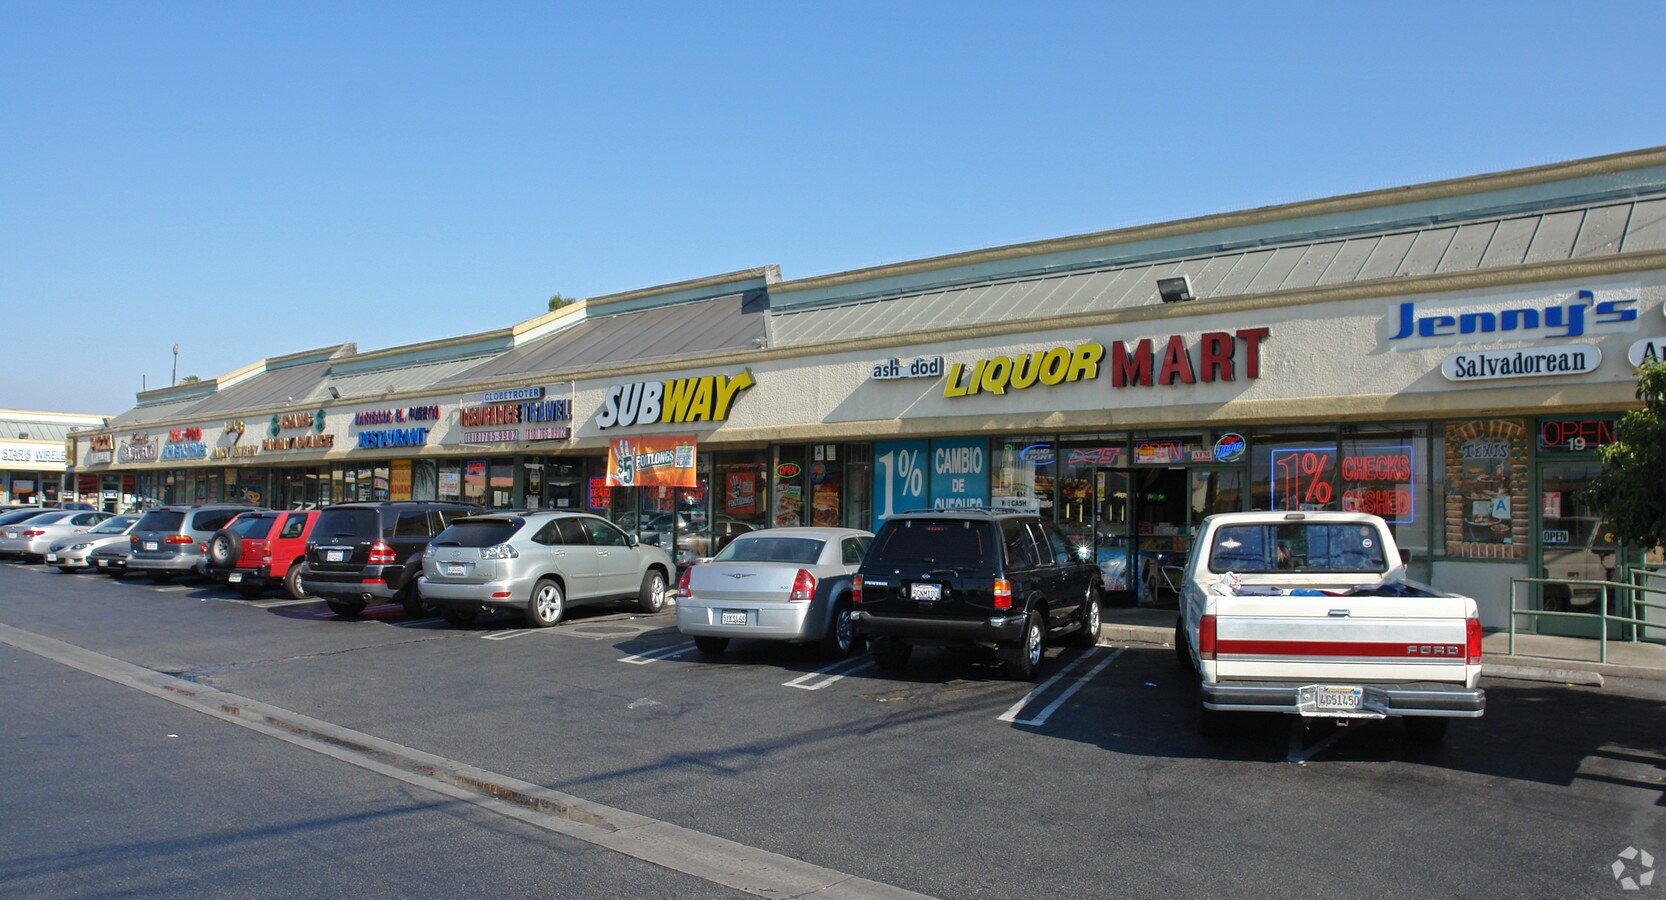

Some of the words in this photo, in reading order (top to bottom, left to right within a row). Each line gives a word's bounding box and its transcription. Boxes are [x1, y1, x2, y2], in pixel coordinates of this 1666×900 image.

[1389, 290, 1638, 338] Jenny's
[873, 362, 899, 378] ash
[911, 357, 938, 375] dod
[943, 343, 1103, 398] LIQUOR
[1112, 328, 1269, 387] MART
[1455, 352, 1586, 378] Salvadorean
[484, 388, 539, 401] GLOBETROTER
[595, 368, 752, 429] SUBWAY
[460, 404, 518, 427] INSURANCE
[523, 398, 570, 422] TRAVEL
[358, 427, 427, 448] RESTAURANT
[1543, 420, 1618, 446] OPEN
[3, 449, 31, 459] STAR'S
[816, 448, 822, 456] A
[1140, 443, 1181, 460] OPEN
[1193, 450, 1211, 458] ATM
[1567, 437, 1585, 451] 19
[636, 450, 674, 468] FOOTLONGS
[935, 447, 982, 475] CAMBIO
[1342, 455, 1410, 481] CHECKS
[779, 465, 797, 475] OPEN
[878, 449, 923, 519] 1%
[952, 479, 965, 493] DE
[1277, 452, 1331, 511] 1%
[1342, 490, 1410, 515] CASHED
[1496, 499, 1507, 511] A
[1544, 533, 1567, 542] OPEN
[1407, 645, 1459, 655] FORD
